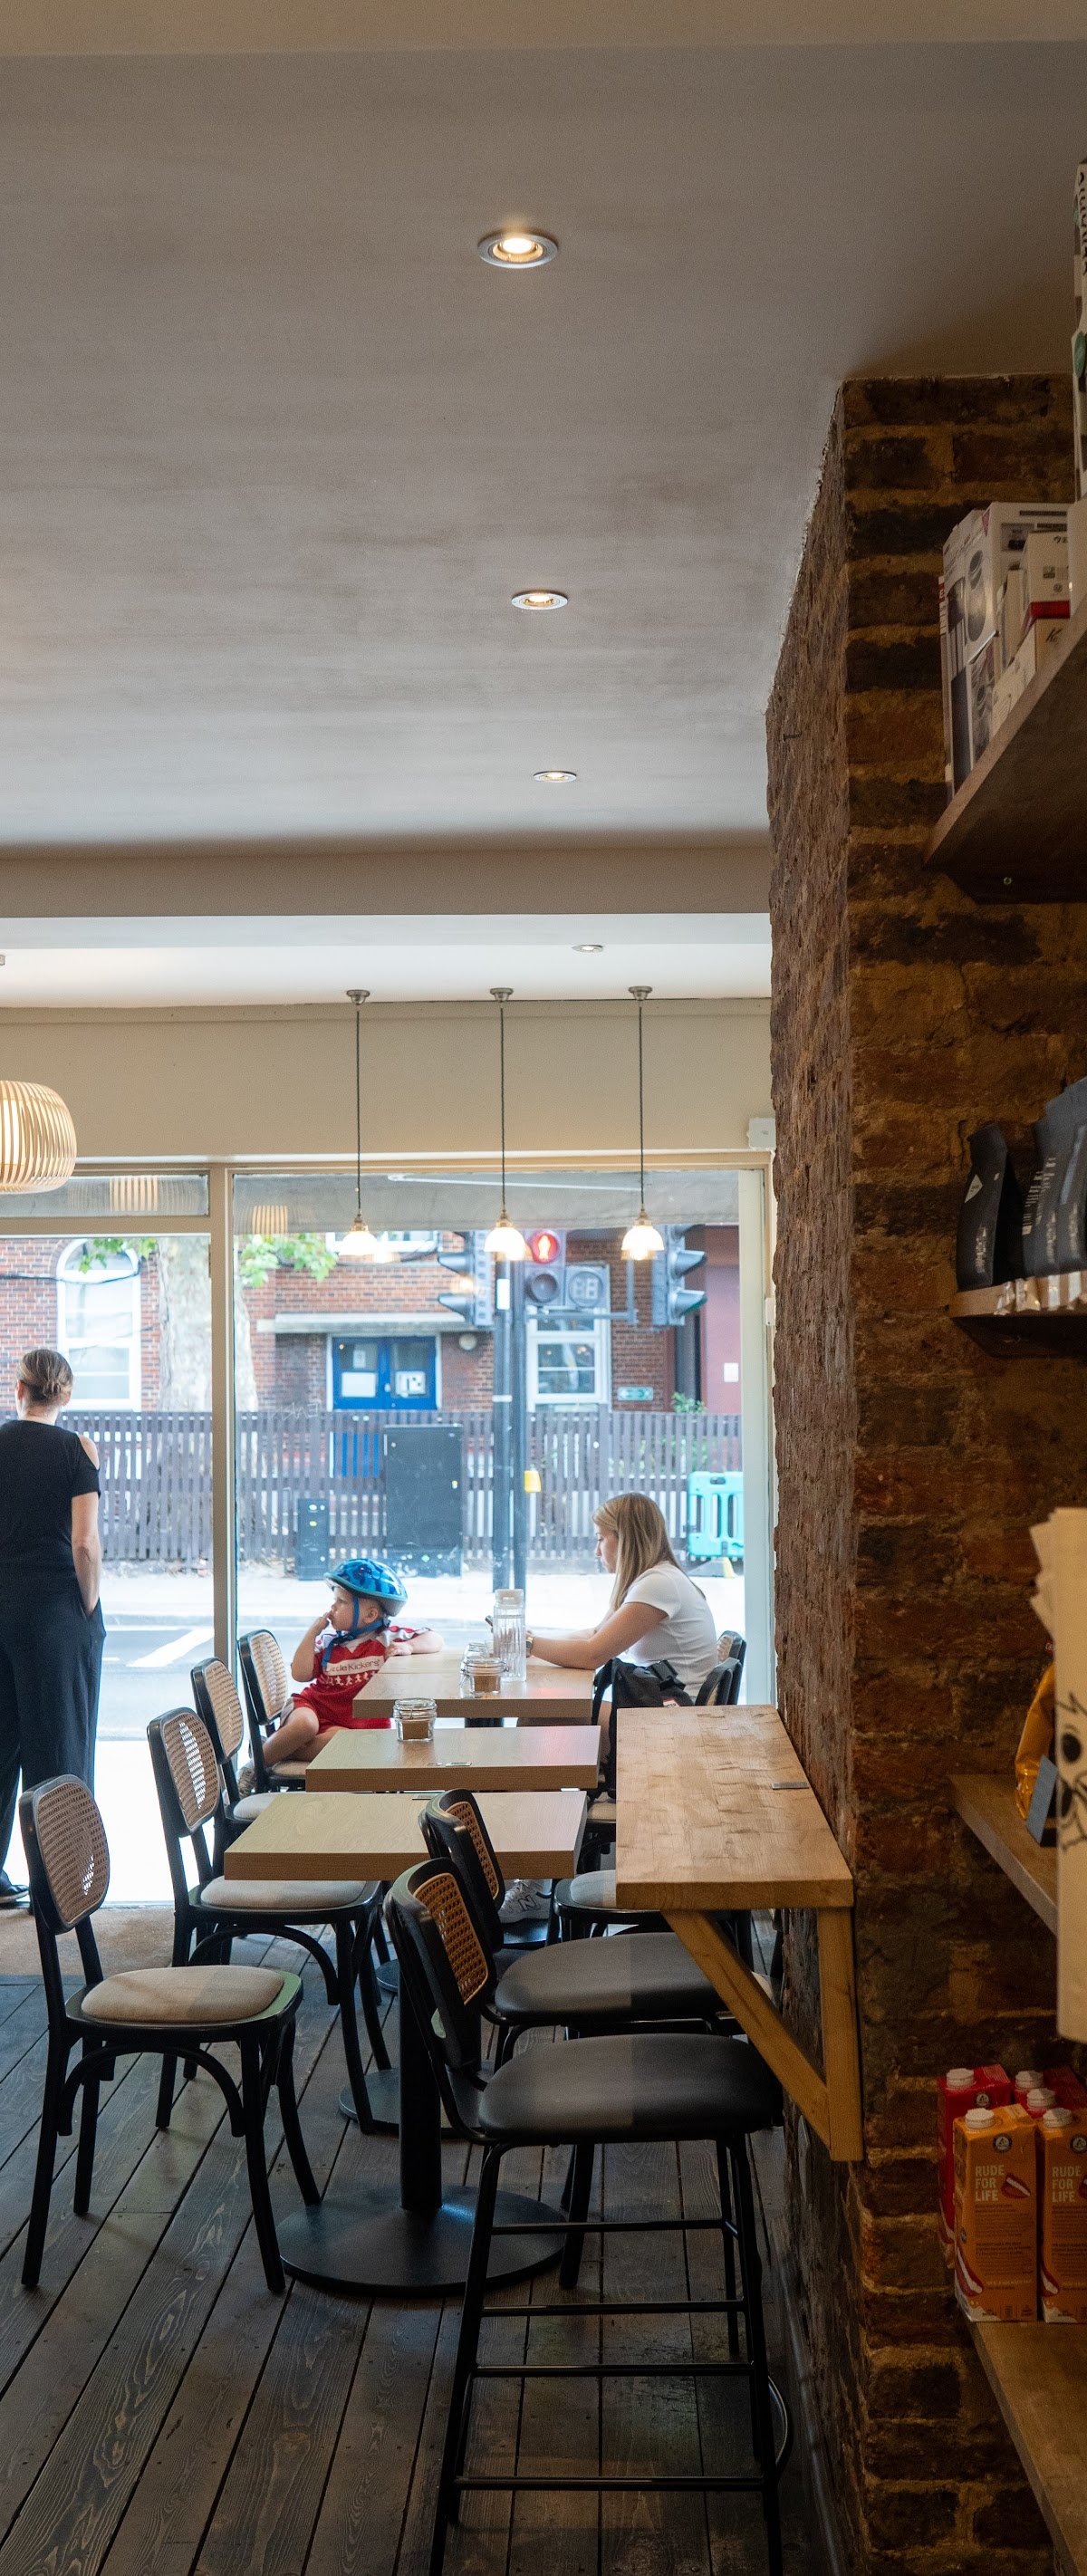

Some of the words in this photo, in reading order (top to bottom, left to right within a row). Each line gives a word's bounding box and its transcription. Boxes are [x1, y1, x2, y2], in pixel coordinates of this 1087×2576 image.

[976, 2165, 1004, 2177] RUDE
[1053, 2166, 1082, 2177] RUDE
[976, 2177, 996, 2189] FOR
[1052, 2178, 1073, 2189] FOR
[976, 2190, 998, 2202] LIFE
[1052, 2191, 1075, 2203] LIFE
